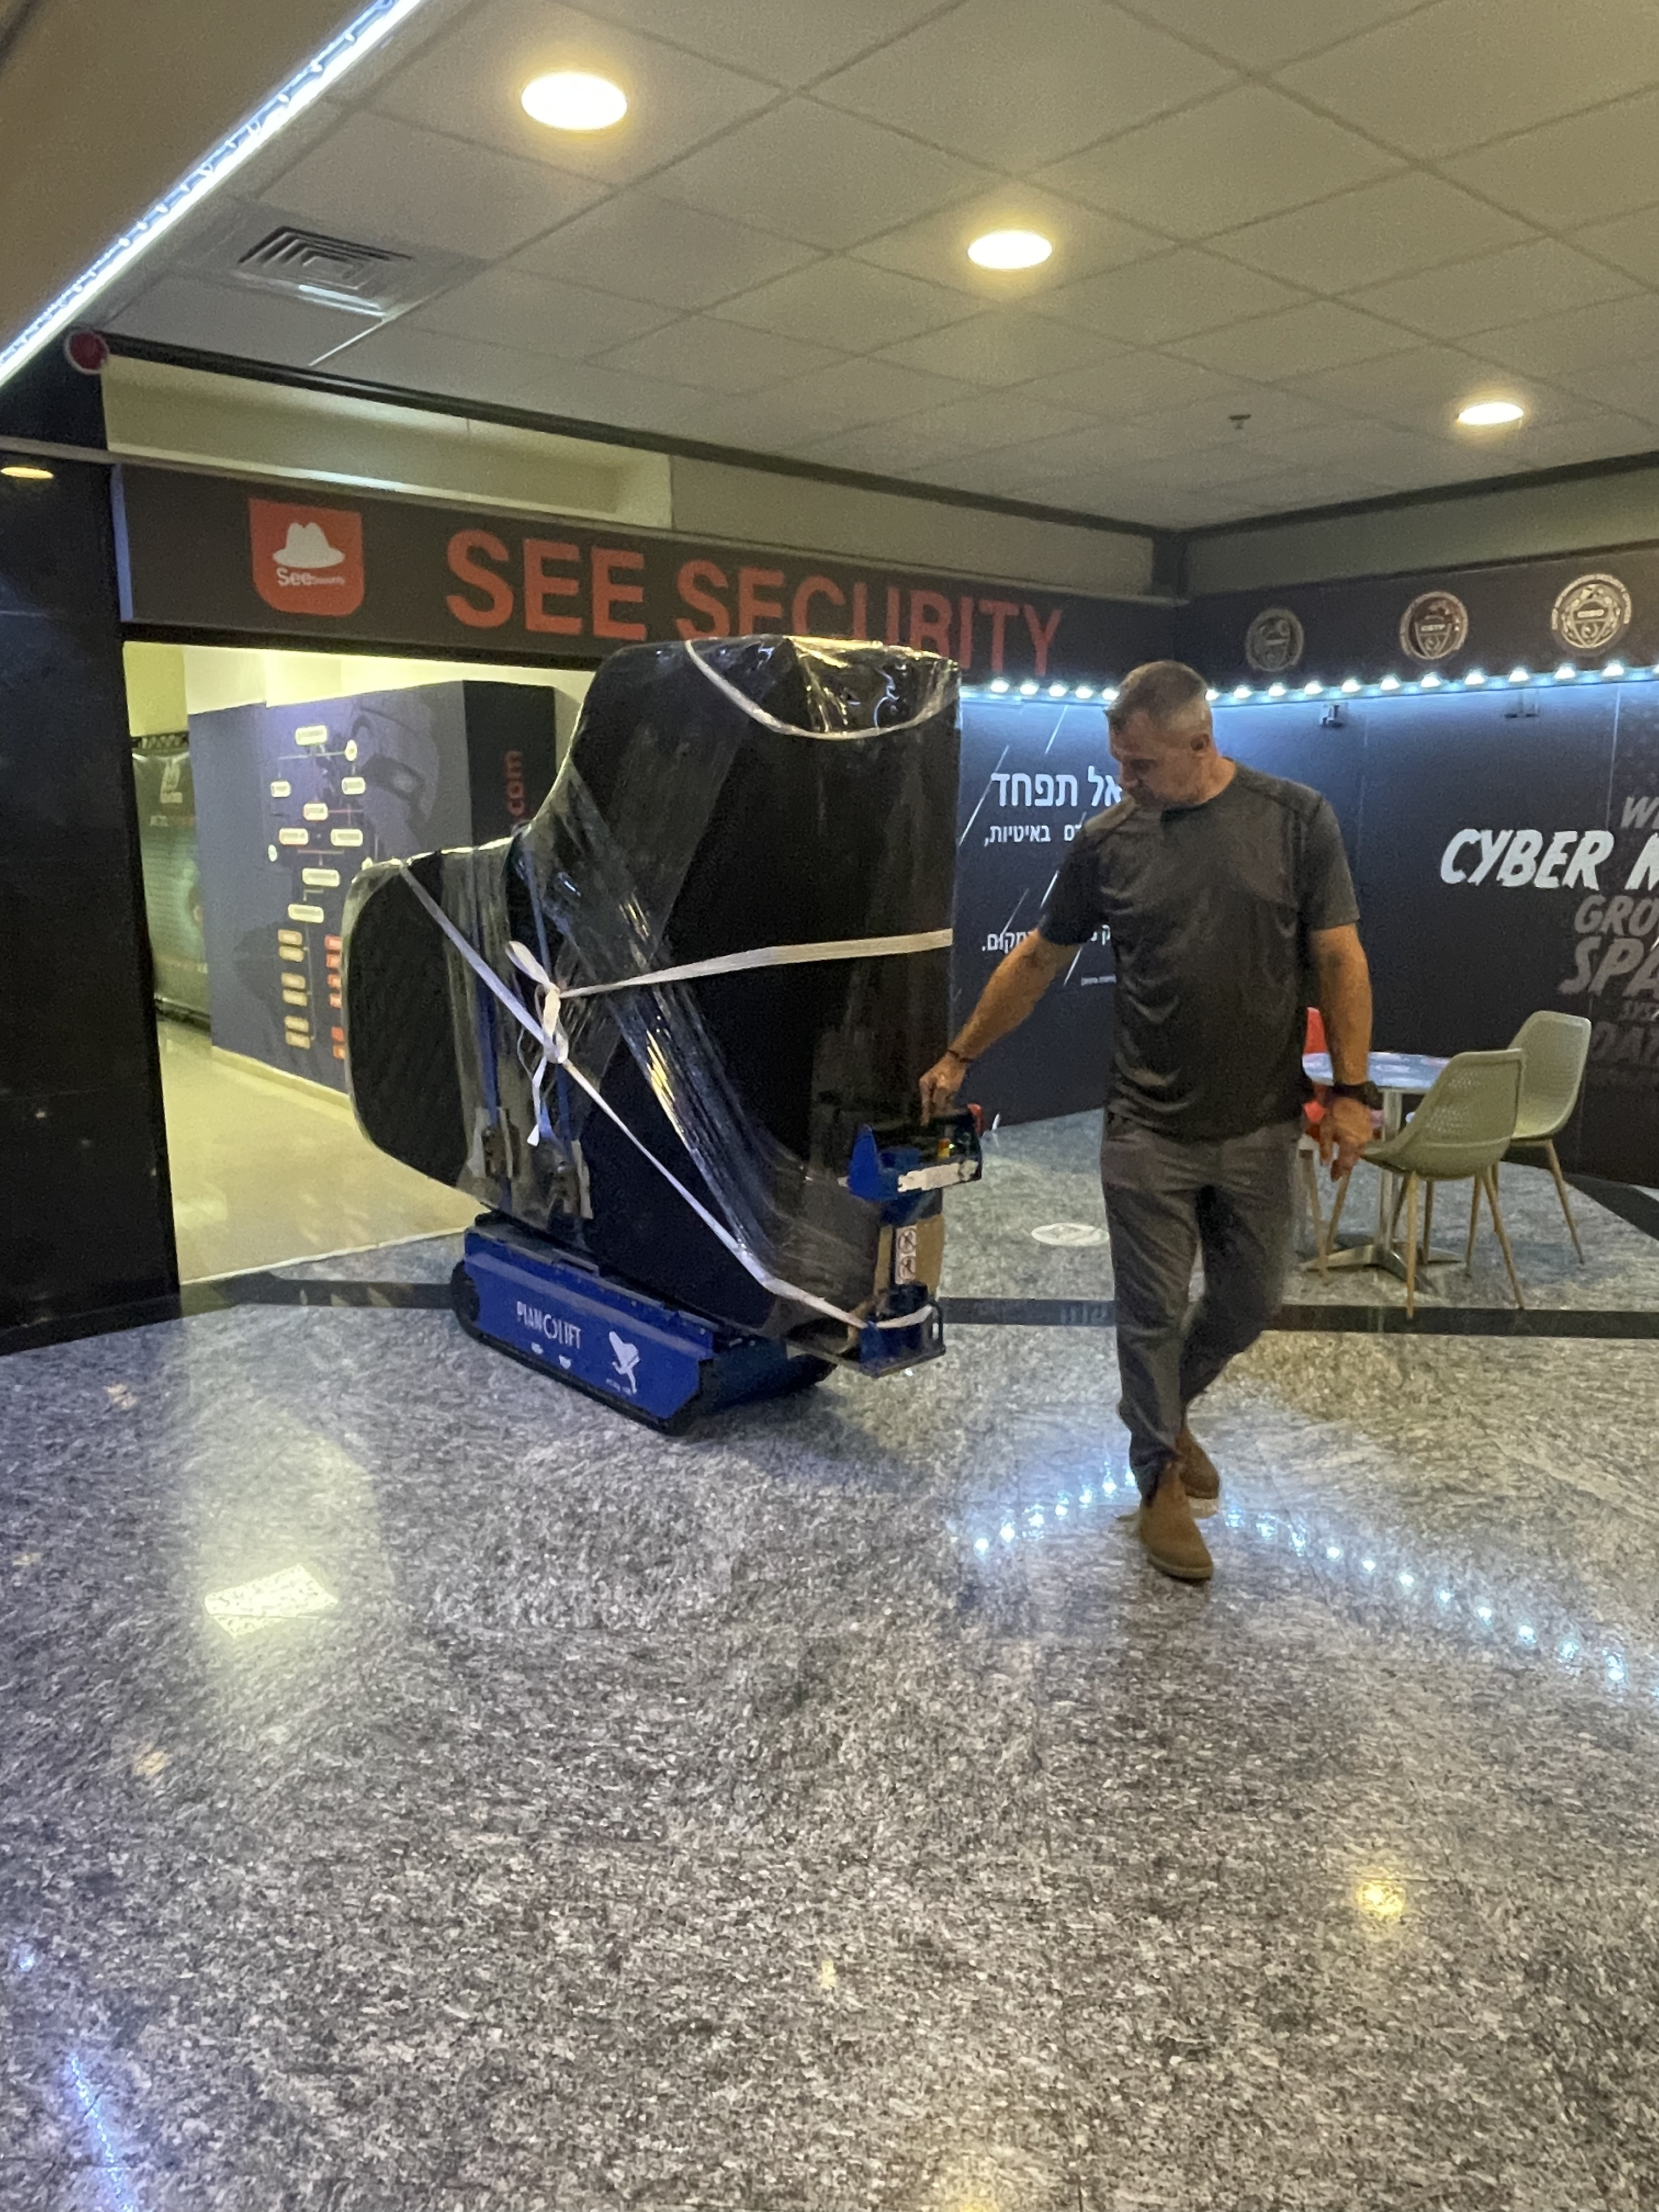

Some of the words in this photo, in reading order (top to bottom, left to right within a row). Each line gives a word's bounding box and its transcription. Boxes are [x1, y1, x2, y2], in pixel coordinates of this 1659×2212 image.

[446, 529, 647, 641] SEE
[676, 558, 1062, 677] SECURITY
[990, 772, 1078, 807] תפחד
[1087, 765, 1122, 807] אל
[984, 824, 1052, 847] באיטיות,
[1440, 828, 1615, 890] CYBER
